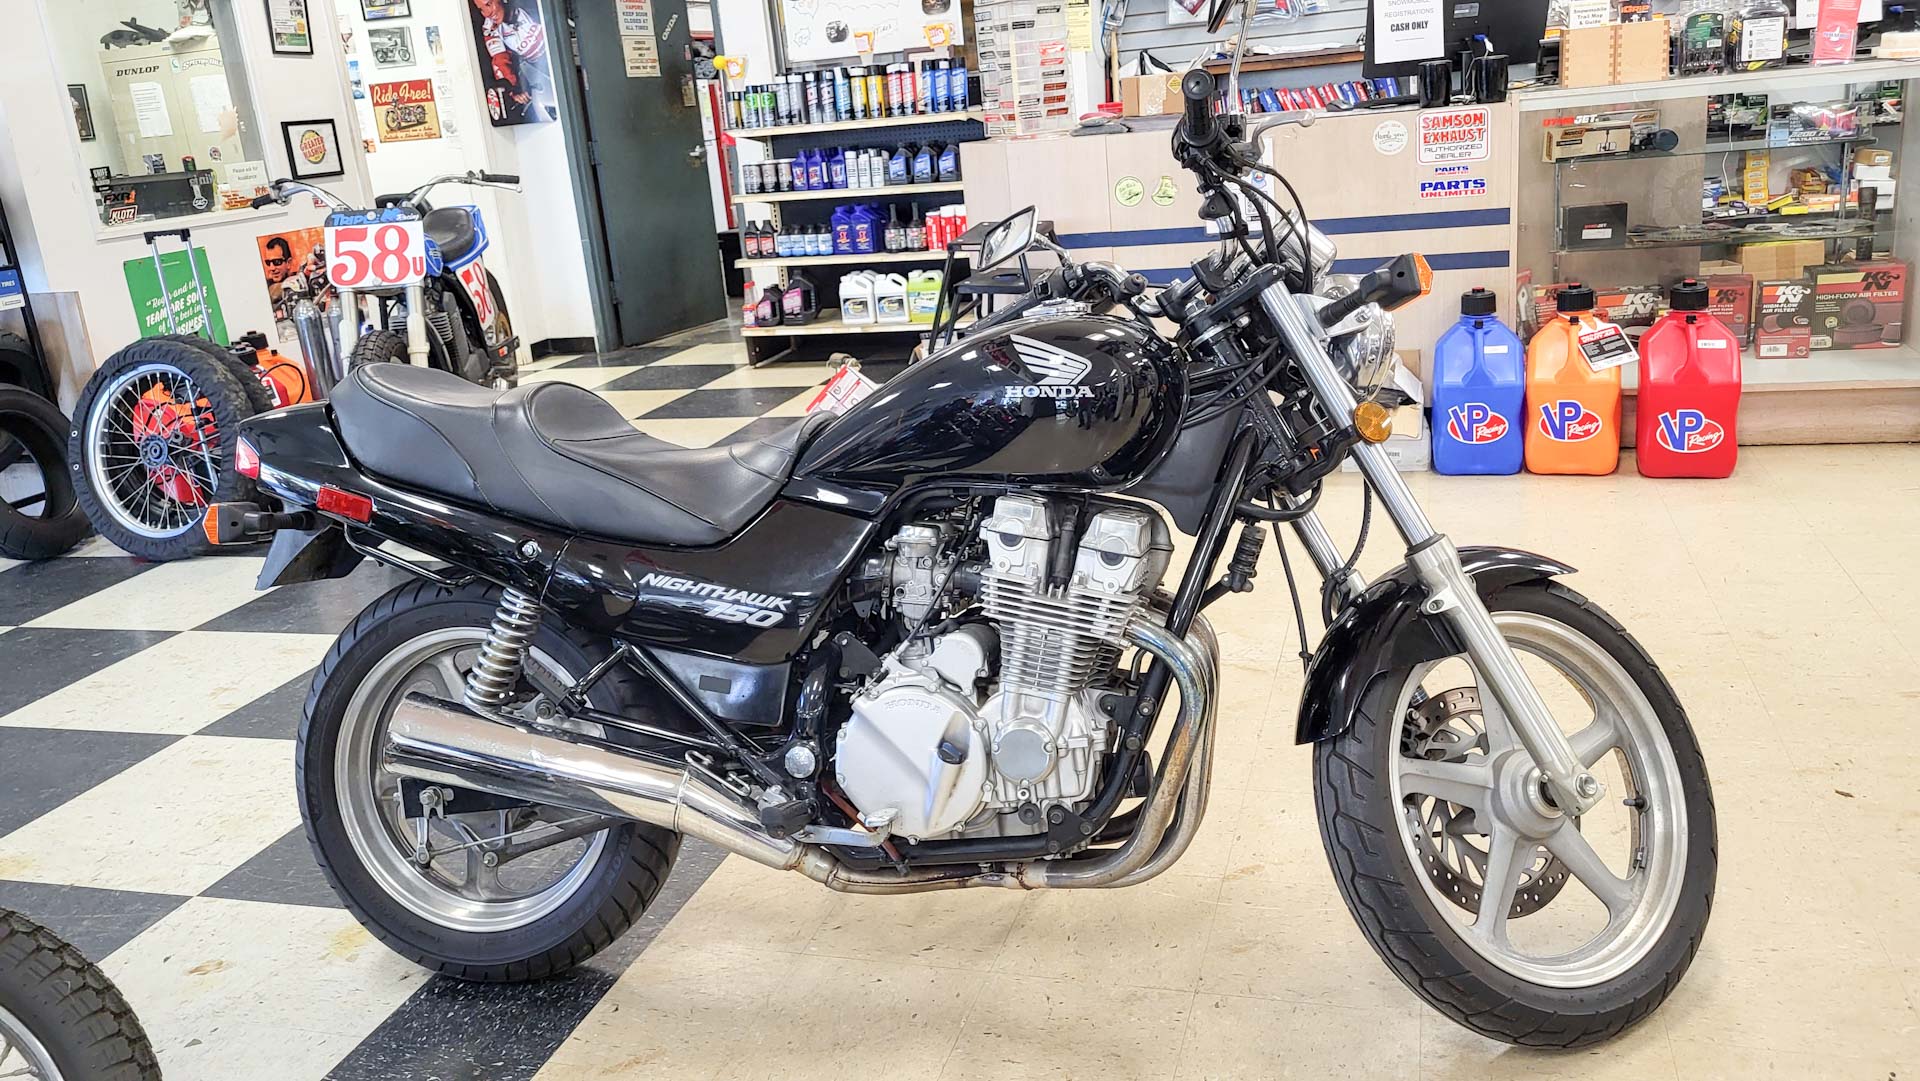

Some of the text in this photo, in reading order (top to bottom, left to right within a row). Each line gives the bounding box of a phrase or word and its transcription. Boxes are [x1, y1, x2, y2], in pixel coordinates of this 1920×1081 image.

[1390, 20, 1429, 32] CASH ONLY
[116, 65, 160, 77] DUNLOP
[373, 82, 432, 104] Ride Free!
[1422, 112, 1485, 130] SAMSON
[1423, 127, 1486, 145] EXHAUST
[300, 136, 325, 151] GREATER
[1424, 143, 1483, 153] AUTHORIZED
[1434, 151, 1472, 160] DEALER
[1435, 165, 1469, 173] PARTS
[1420, 178, 1486, 192] PARTS
[1420, 188, 1486, 199] UNLIMITED
[112, 208, 135, 220] KLOTZ
[173, 282, 188, 298] and
[188, 278, 198, 290] th
[1816, 291, 1857, 301] HIGH-FLOW
[1004, 385, 1095, 398] HONDA
[1450, 403, 1507, 442] VP Racing
[1541, 401, 1601, 440] VP Racing
[1659, 410, 1723, 451] VP Racing
[638, 572, 792, 612] NIGHTHAWK
[702, 599, 784, 628] 750
